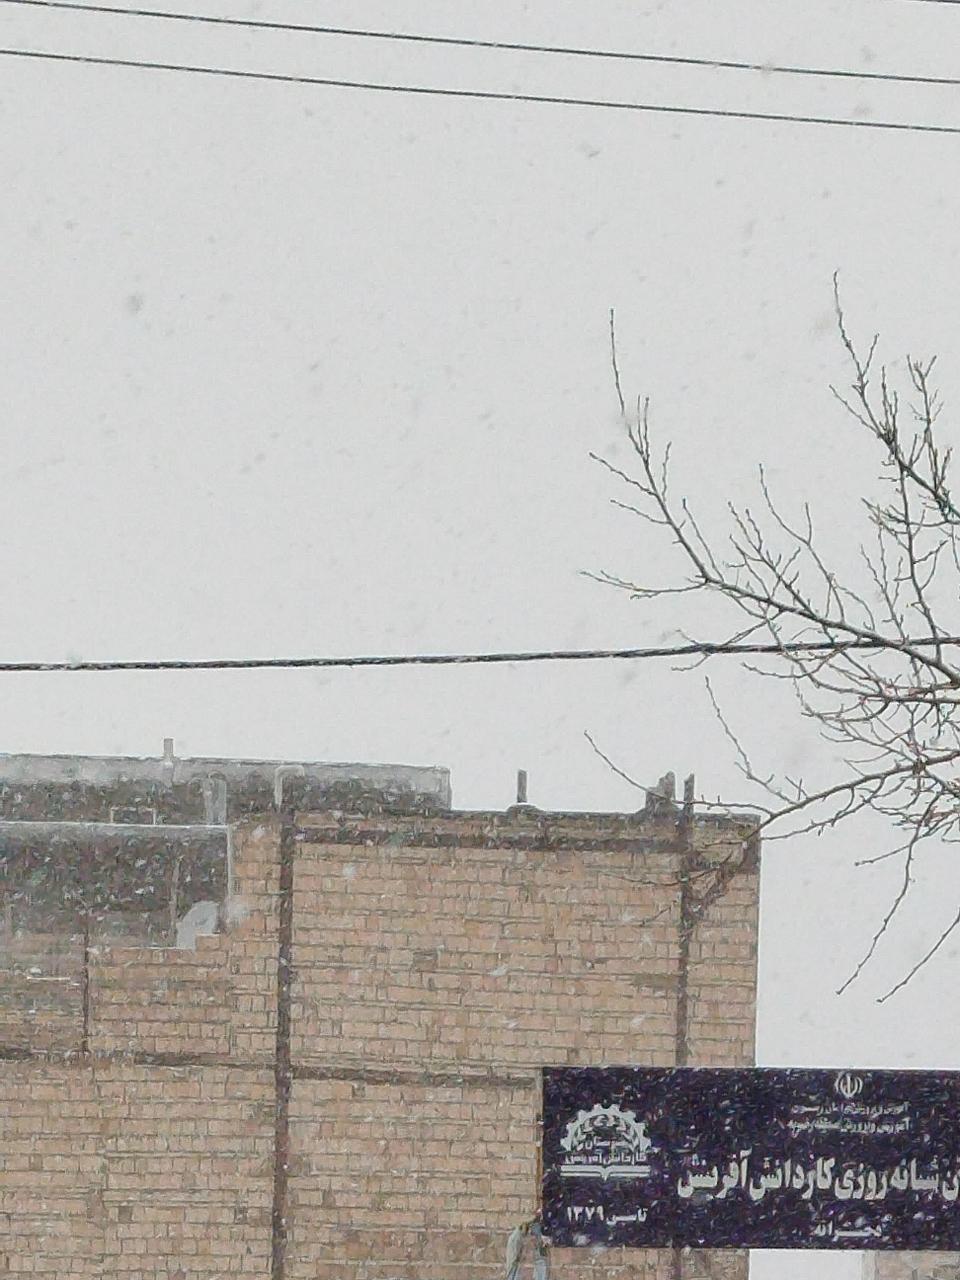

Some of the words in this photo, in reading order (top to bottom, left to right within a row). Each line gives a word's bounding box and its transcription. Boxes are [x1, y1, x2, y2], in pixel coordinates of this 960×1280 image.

[879, 1116, 910, 1135] آموزش
[676, 1149, 752, 1200] آفرینش
[834, 1162, 888, 1201] روزی
[887, 1154, 941, 1198] شبانه
